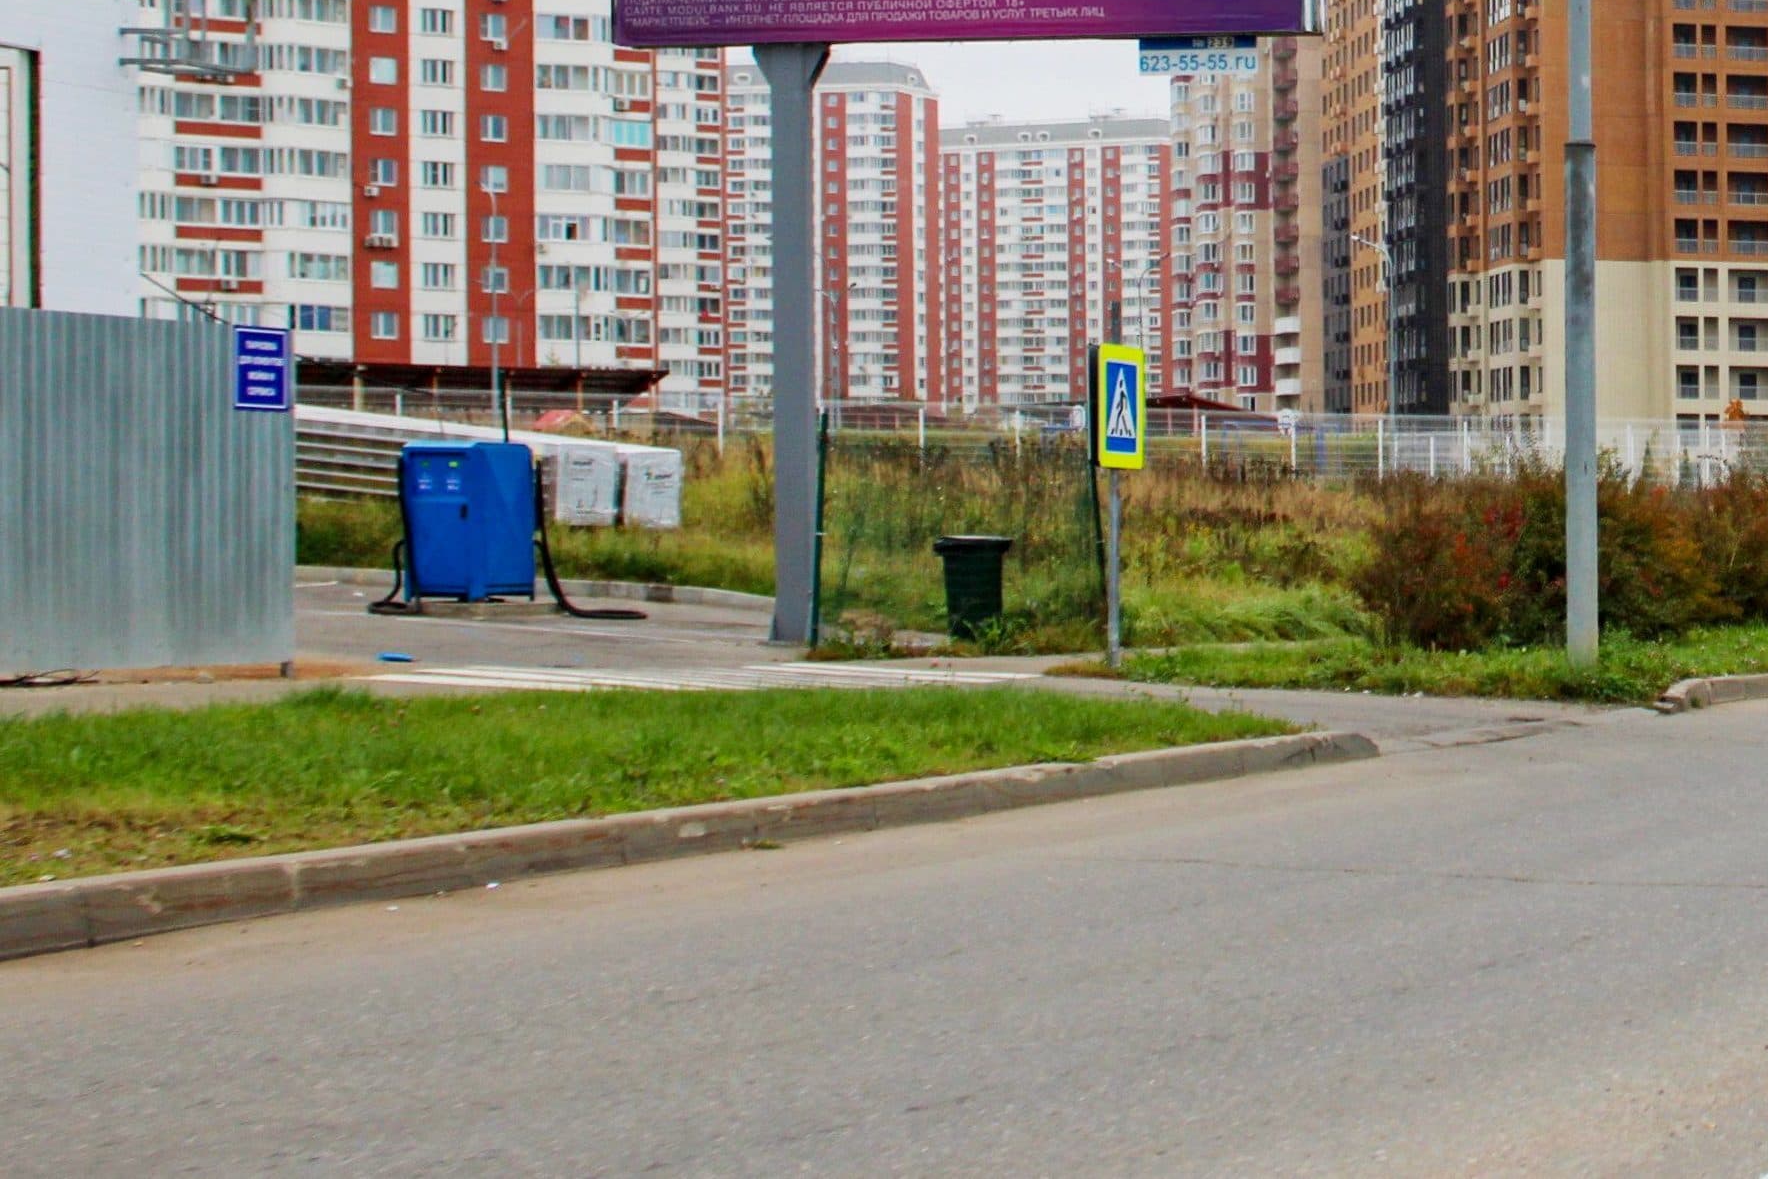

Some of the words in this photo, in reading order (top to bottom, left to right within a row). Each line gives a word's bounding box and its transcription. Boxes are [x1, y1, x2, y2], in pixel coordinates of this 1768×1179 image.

[767, 2, 784, 13] НЕ
[788, 0, 854, 13] ЯВЛЯЕТСЯ
[927, 8, 980, 21] ТОВАРОВ
[1140, 54, 1256, 72] 623-55-55.ru
